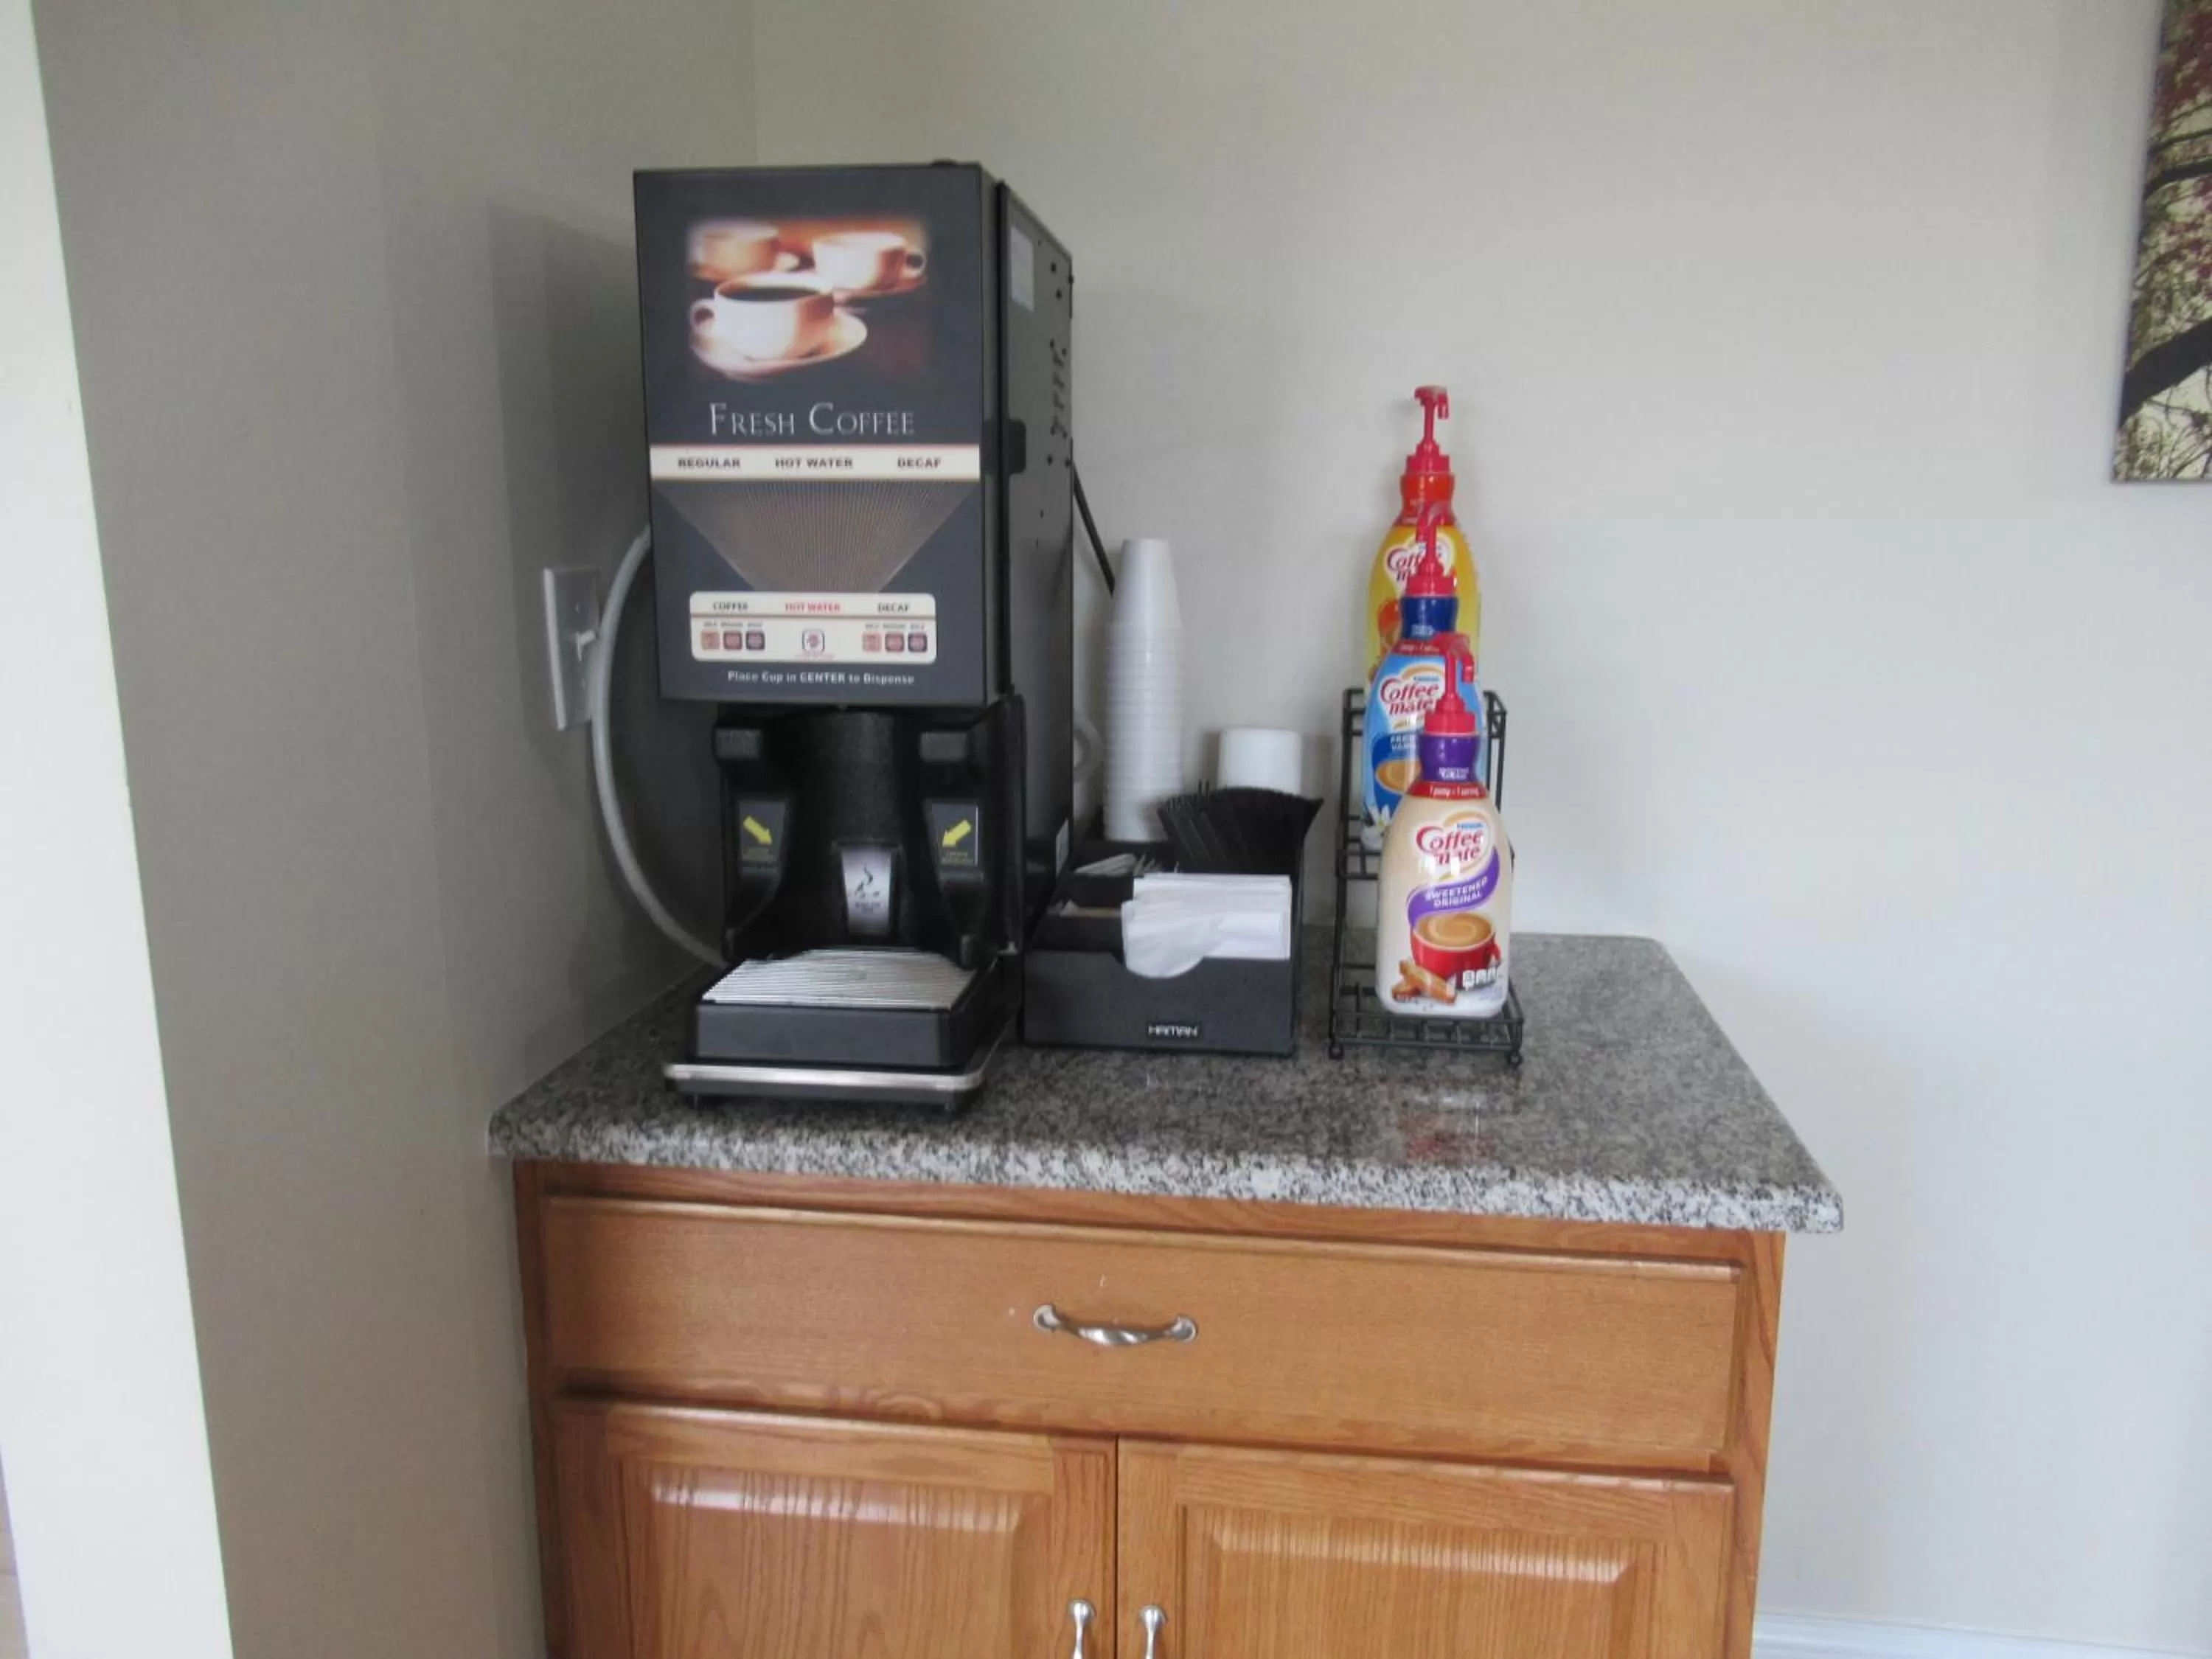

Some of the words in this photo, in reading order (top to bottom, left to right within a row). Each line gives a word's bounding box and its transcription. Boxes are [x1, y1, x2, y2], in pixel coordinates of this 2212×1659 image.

[709, 402, 795, 437] FRESH
[809, 402, 916, 437] COFFEE
[677, 457, 741, 470] REGULAR
[775, 457, 801, 470] HOT
[807, 457, 854, 470] WATER
[897, 456, 942, 470] DECAF
[712, 600, 749, 611] COFFEE
[785, 601, 807, 612] HOT
[810, 602, 841, 612] WATER
[877, 602, 911, 613] DECAF
[727, 670, 759, 683] Place
[762, 670, 783, 684] Cup
[787, 671, 797, 683] in
[799, 672, 846, 685] CENTER
[849, 673, 860, 684] to
[863, 673, 916, 686] Dispense
[1380, 678, 1440, 703] Coffee
[1389, 699, 1433, 717] mate
[1416, 825, 1484, 854] Coffee
[1424, 875, 1488, 902] SWEETENED
[1433, 890, 1482, 908] ORIGINAL
